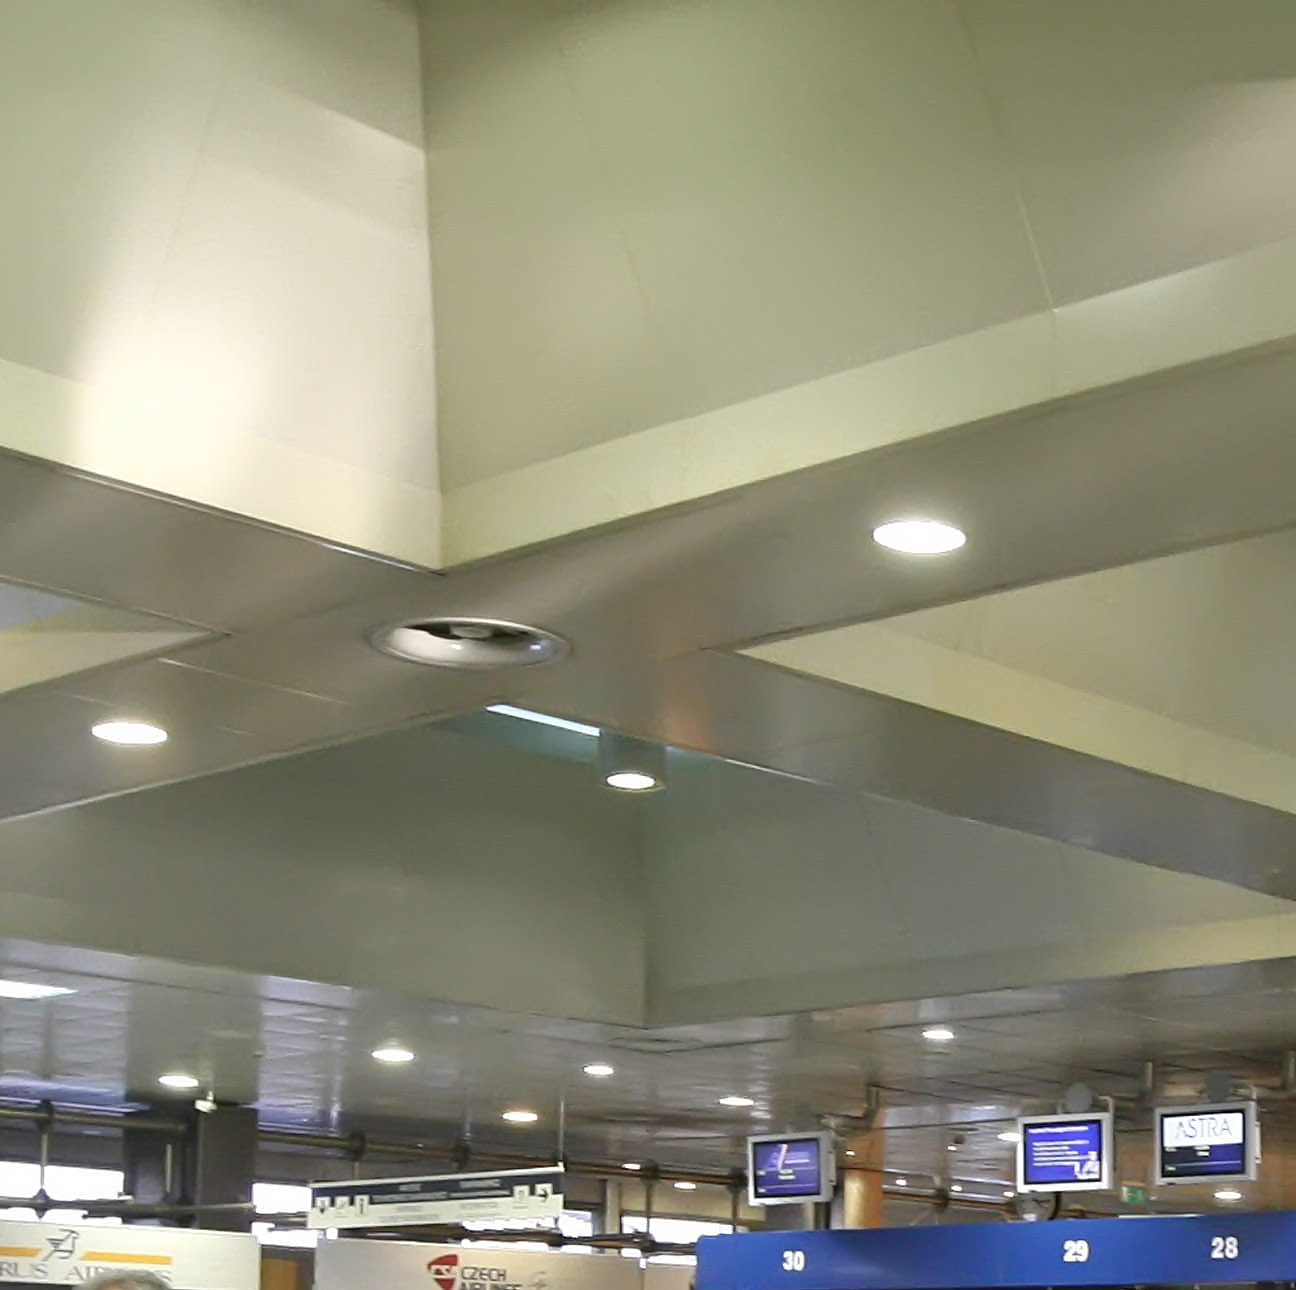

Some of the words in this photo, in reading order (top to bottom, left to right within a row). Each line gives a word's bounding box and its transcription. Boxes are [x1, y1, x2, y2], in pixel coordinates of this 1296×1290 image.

[1175, 1117, 1232, 1140] ASTRA
[1063, 1239, 1089, 1262] 29
[1211, 1236, 1239, 1259] 28
[782, 1250, 805, 1271] 30
[461, 1266, 506, 1281] CZECH
